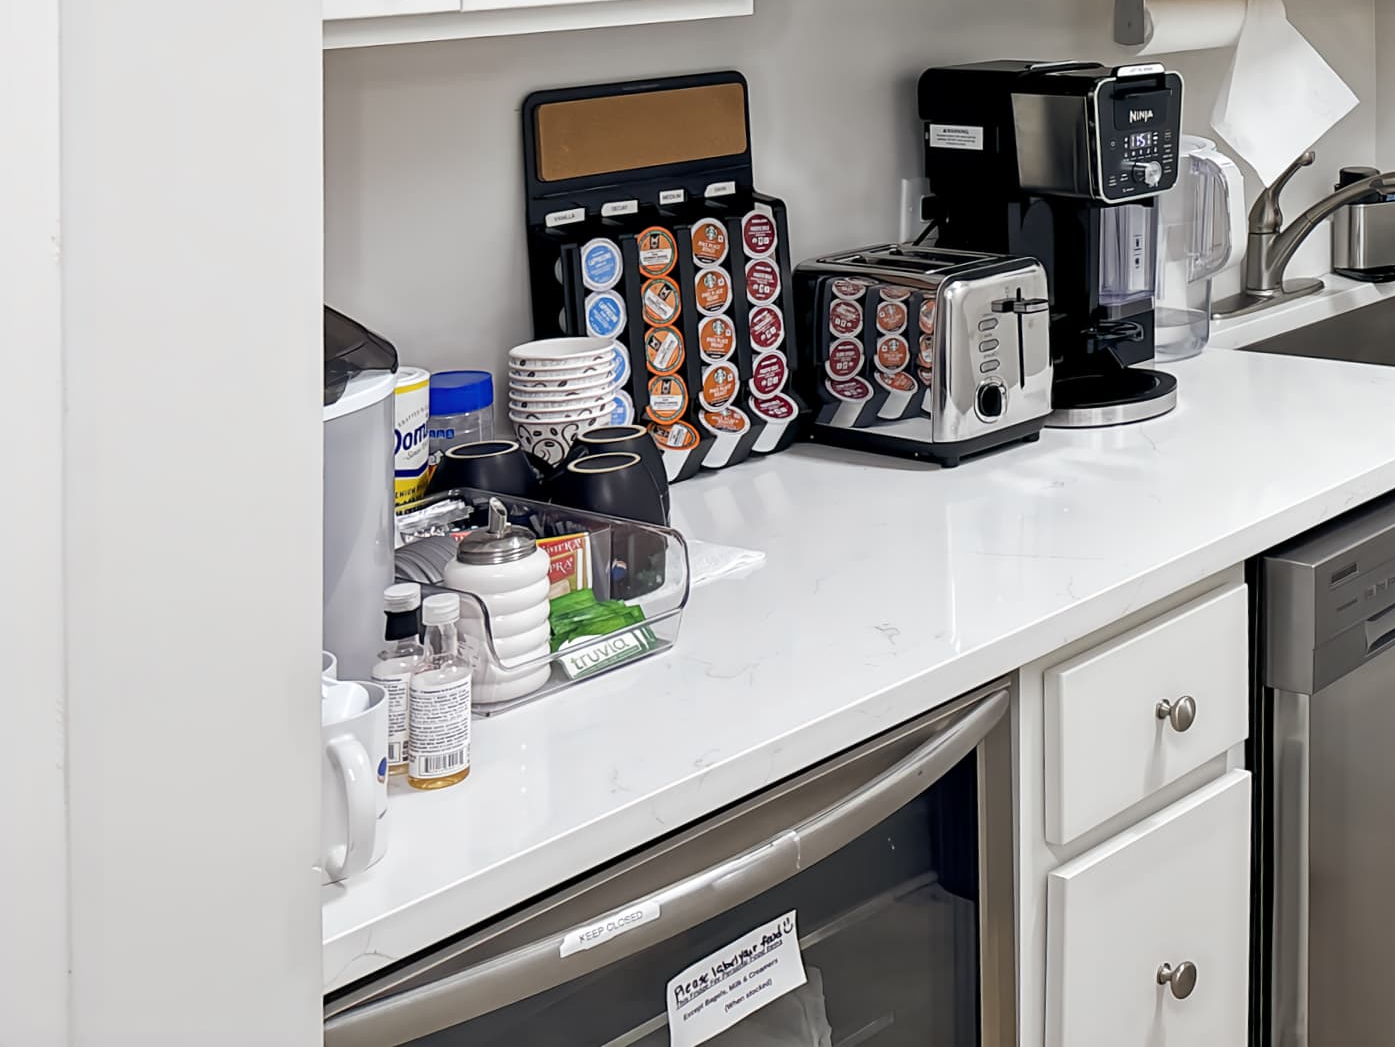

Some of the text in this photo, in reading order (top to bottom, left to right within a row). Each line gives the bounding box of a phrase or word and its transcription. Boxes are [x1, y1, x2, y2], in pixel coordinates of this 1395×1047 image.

[570, 636, 630, 671] truvia
[579, 911, 643, 943] KEEP CLOSED
